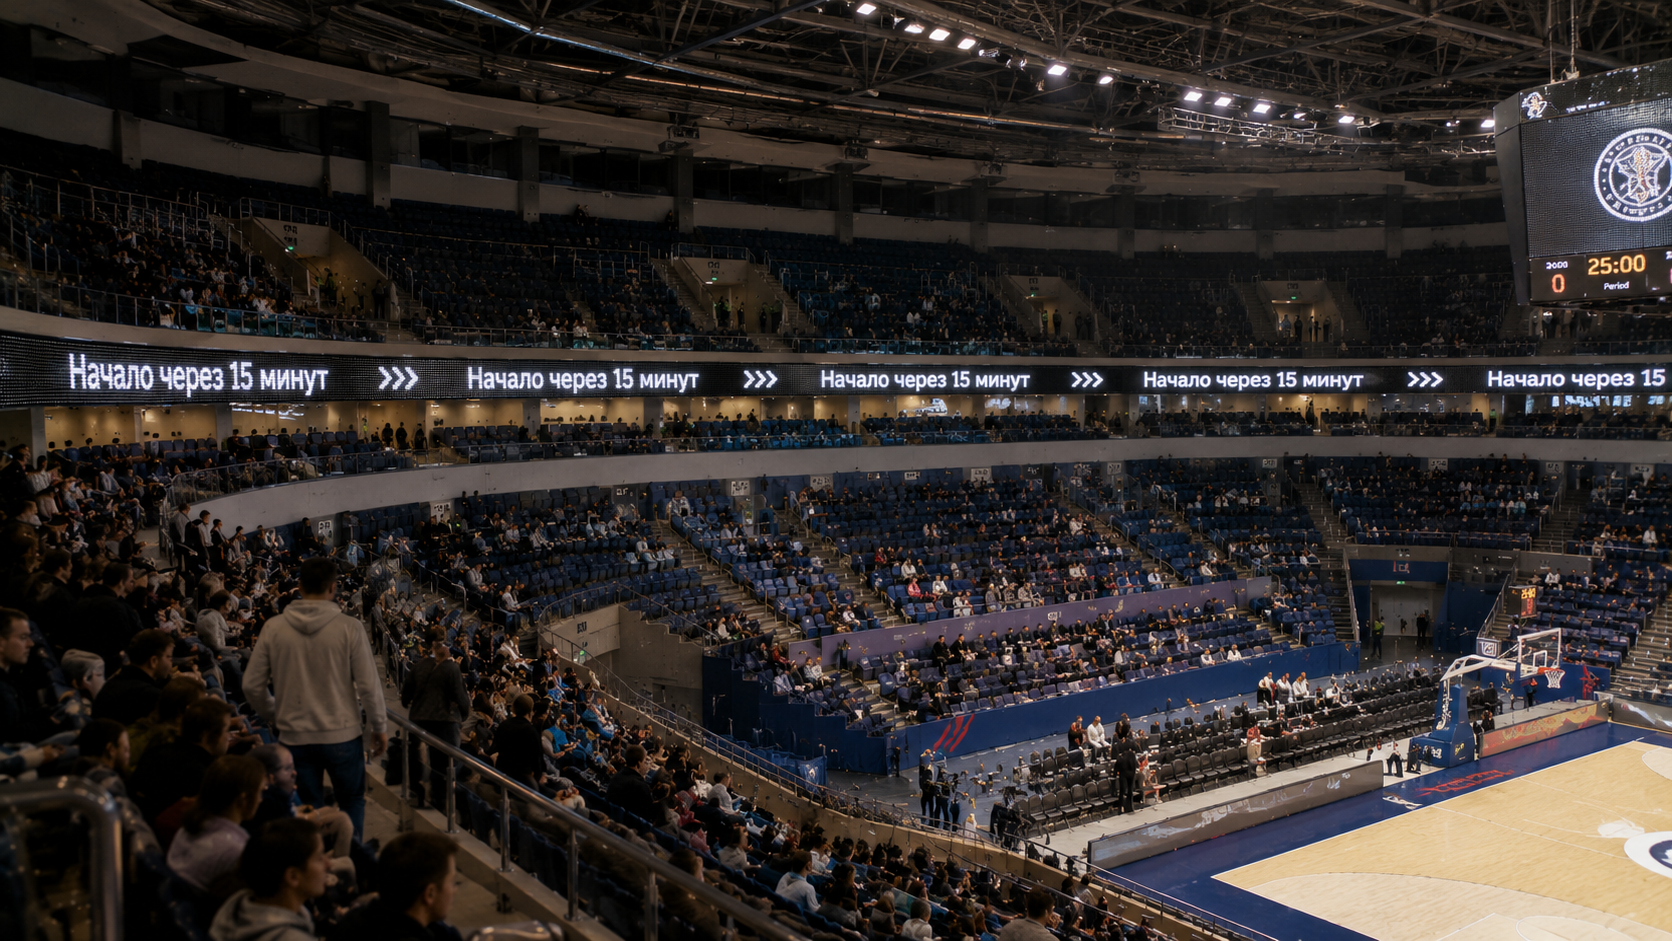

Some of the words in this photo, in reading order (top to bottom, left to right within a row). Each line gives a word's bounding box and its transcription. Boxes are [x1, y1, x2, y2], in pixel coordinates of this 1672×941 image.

[1587, 254, 1647, 276] 25:00
[1551, 273, 1566, 293] 0
[1603, 281, 1630, 291] Period
[69, 353, 155, 390] Начало
[159, 364, 225, 398] через
[229, 360, 254, 391] 15
[260, 367, 329, 397] минут
[467, 366, 545, 390] Начало
[549, 371, 608, 394] через
[612, 368, 635, 390] 15
[639, 372, 700, 394] минут
[820, 369, 890, 388] Начало
[894, 374, 948, 391] через
[951, 370, 971, 388] 15
[975, 374, 1031, 391] минут
[1143, 370, 1212, 388] Начало
[1216, 374, 1272, 390] через
[1276, 371, 1298, 388] 15
[1302, 374, 1364, 390] минут
[1487, 370, 1566, 388] Начало
[1571, 373, 1634, 390] через
[1640, 369, 1666, 386] 15
